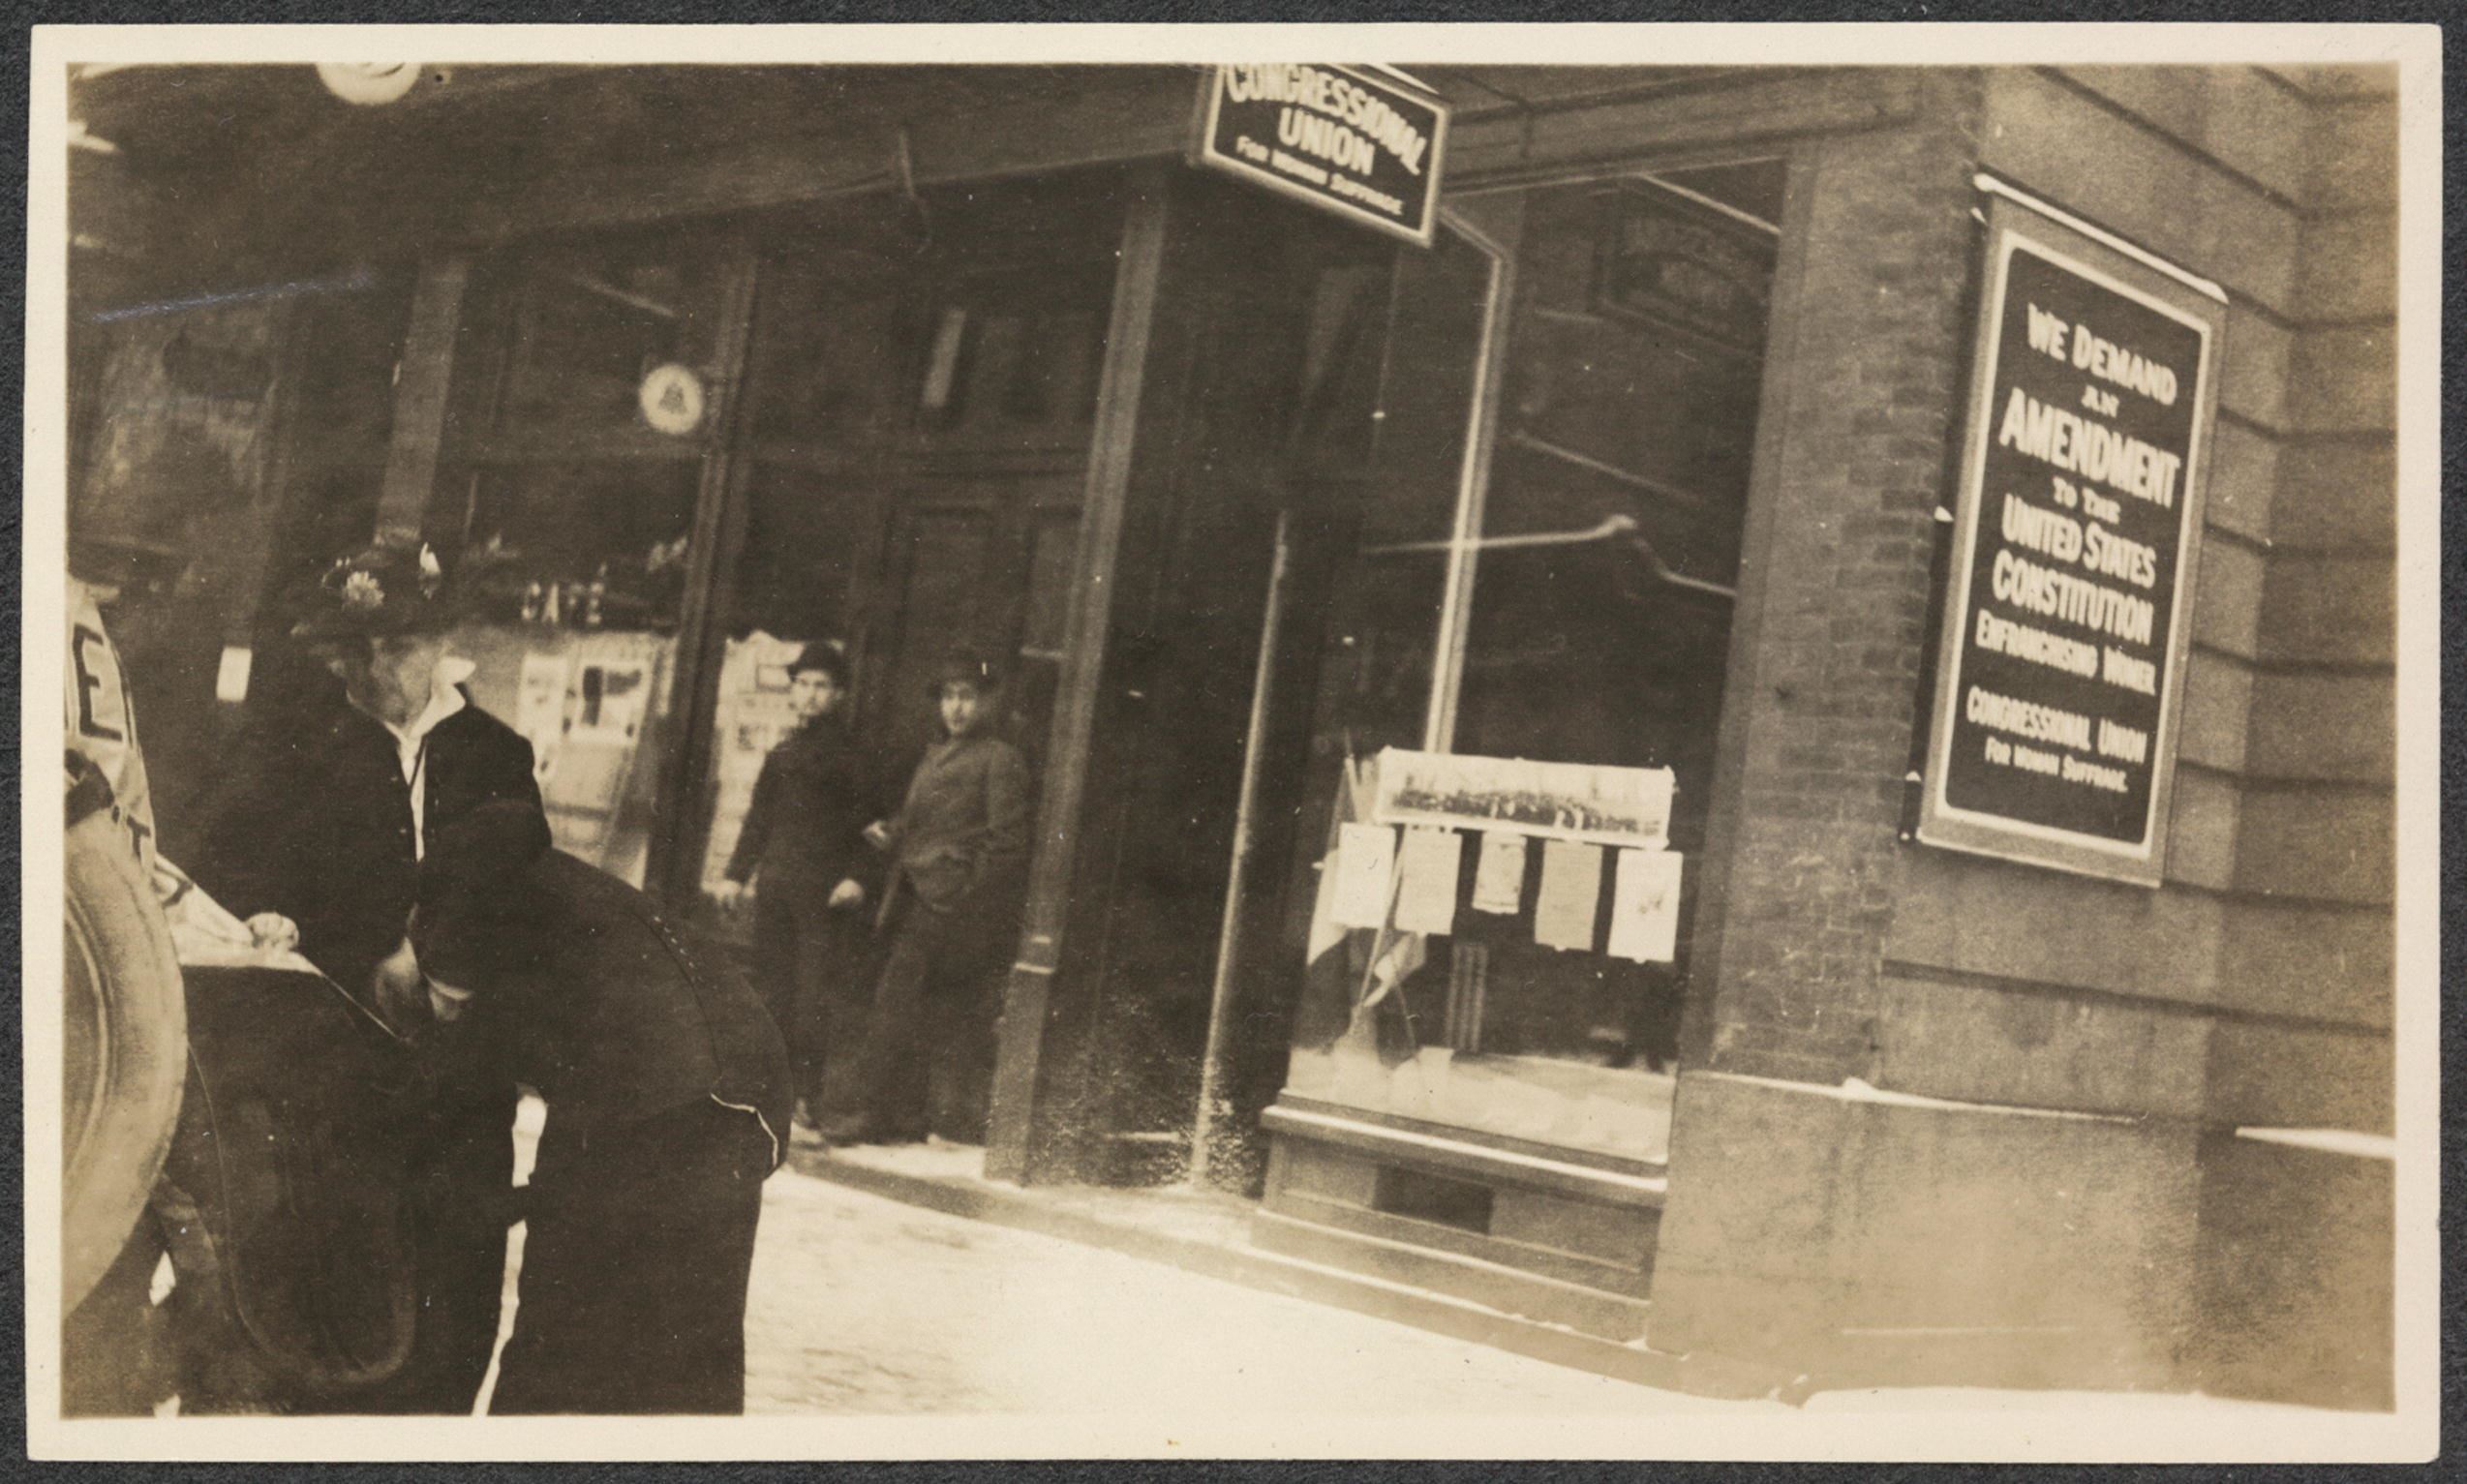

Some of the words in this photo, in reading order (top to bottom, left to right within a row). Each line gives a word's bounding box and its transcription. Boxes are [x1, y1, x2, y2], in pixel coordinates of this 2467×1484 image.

[1226, 64, 1427, 175] CONGRESSIONAL
[1236, 136, 1269, 162] FOR
[1278, 107, 1375, 176] UNION
[2027, 302, 2069, 362] WE
[2072, 323, 2178, 406] DEMAND
[2081, 384, 2120, 418] AN
[1999, 387, 2181, 508] AMENDMENT
[2000, 493, 2083, 562] UNITED
[2083, 524, 2157, 589] STATES
[2052, 477, 2078, 508] TO
[2083, 487, 2121, 524] THE
[1992, 550, 2154, 645] CONSTITUTION
[1975, 609, 2098, 678] ENFRANCHISING
[2103, 646, 2156, 696] WOMEN
[1966, 685, 2091, 752] CONGRESSIONAL
[2097, 717, 2148, 764] UNION
[1985, 736, 2012, 765] FOR
[2013, 744, 2059, 775] WOMAN
